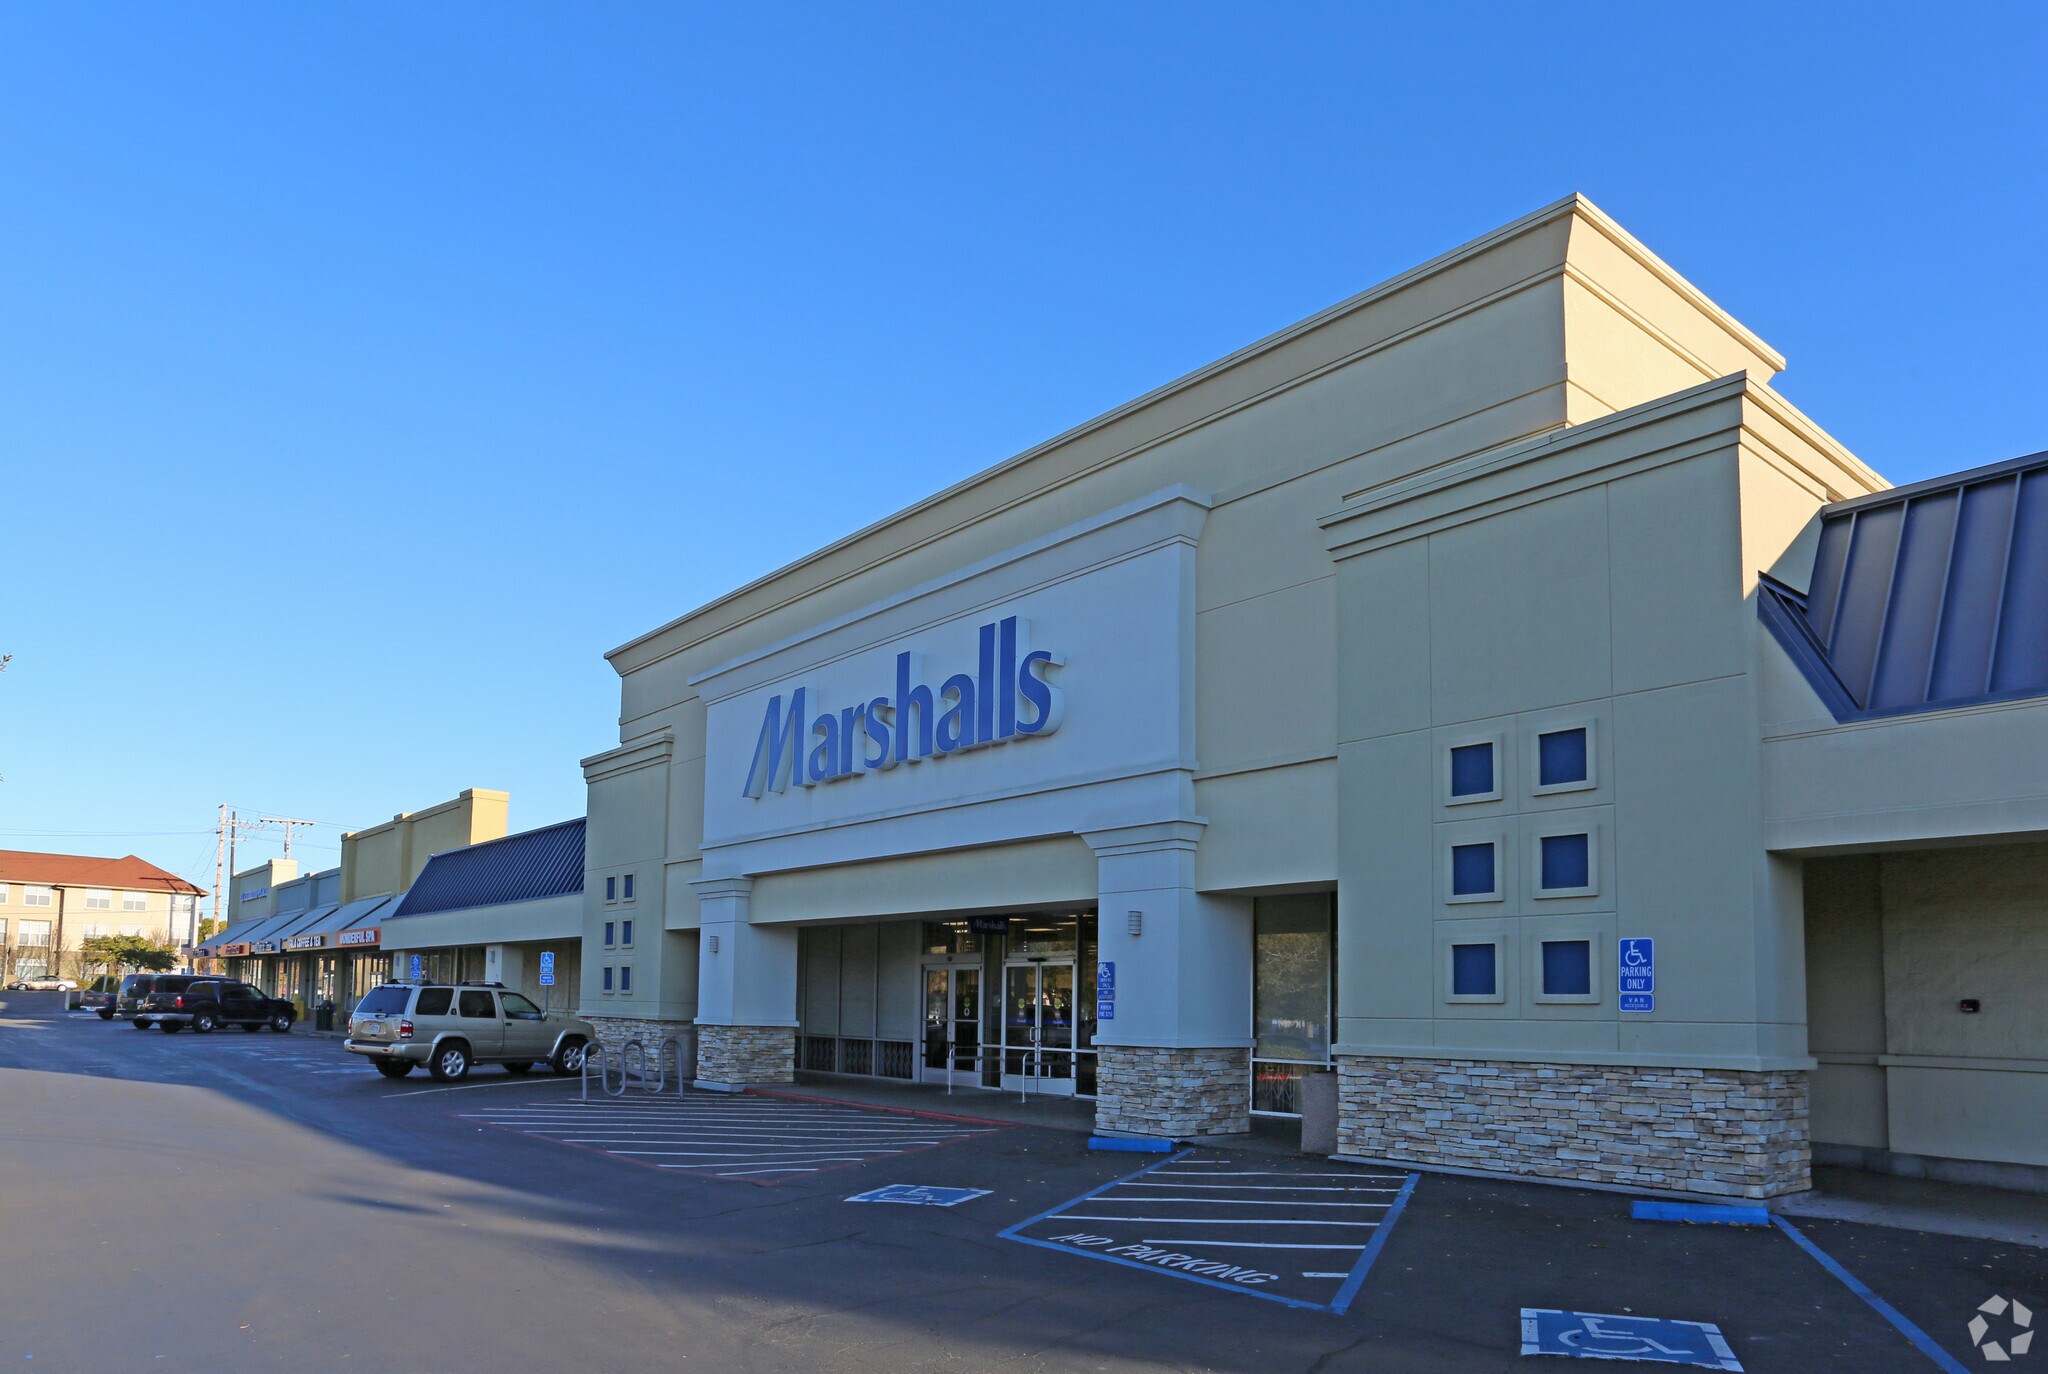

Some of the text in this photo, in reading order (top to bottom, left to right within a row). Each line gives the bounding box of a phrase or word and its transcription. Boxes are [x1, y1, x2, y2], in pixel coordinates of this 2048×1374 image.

[742, 615, 1056, 798] Marshalls
[1621, 966, 1652, 977] PARKING
[1627, 978, 1645, 989] ONLY
[1048, 1233, 1279, 1284] NO PARKING
